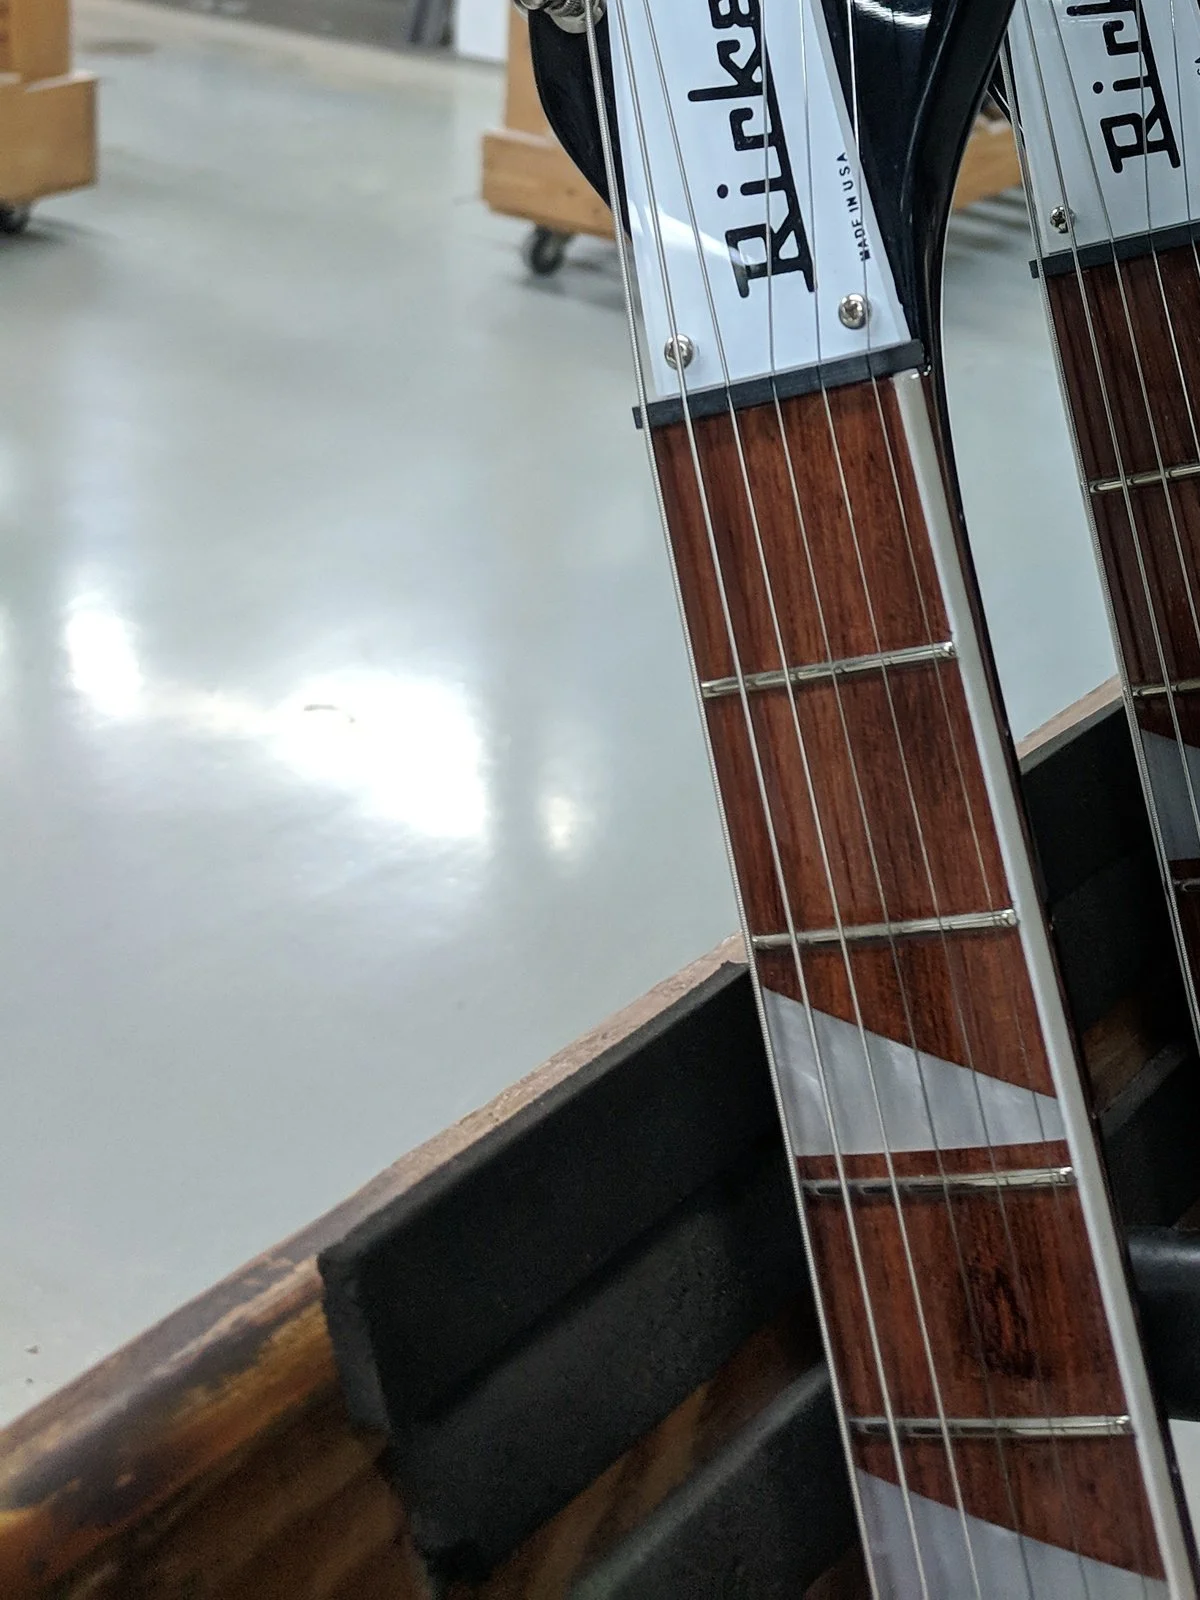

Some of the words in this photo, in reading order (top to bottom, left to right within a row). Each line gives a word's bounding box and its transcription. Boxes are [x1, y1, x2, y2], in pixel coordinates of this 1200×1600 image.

[836, 151, 854, 192] USA
[845, 195, 859, 213] IN
[851, 218, 871, 262] MADE
